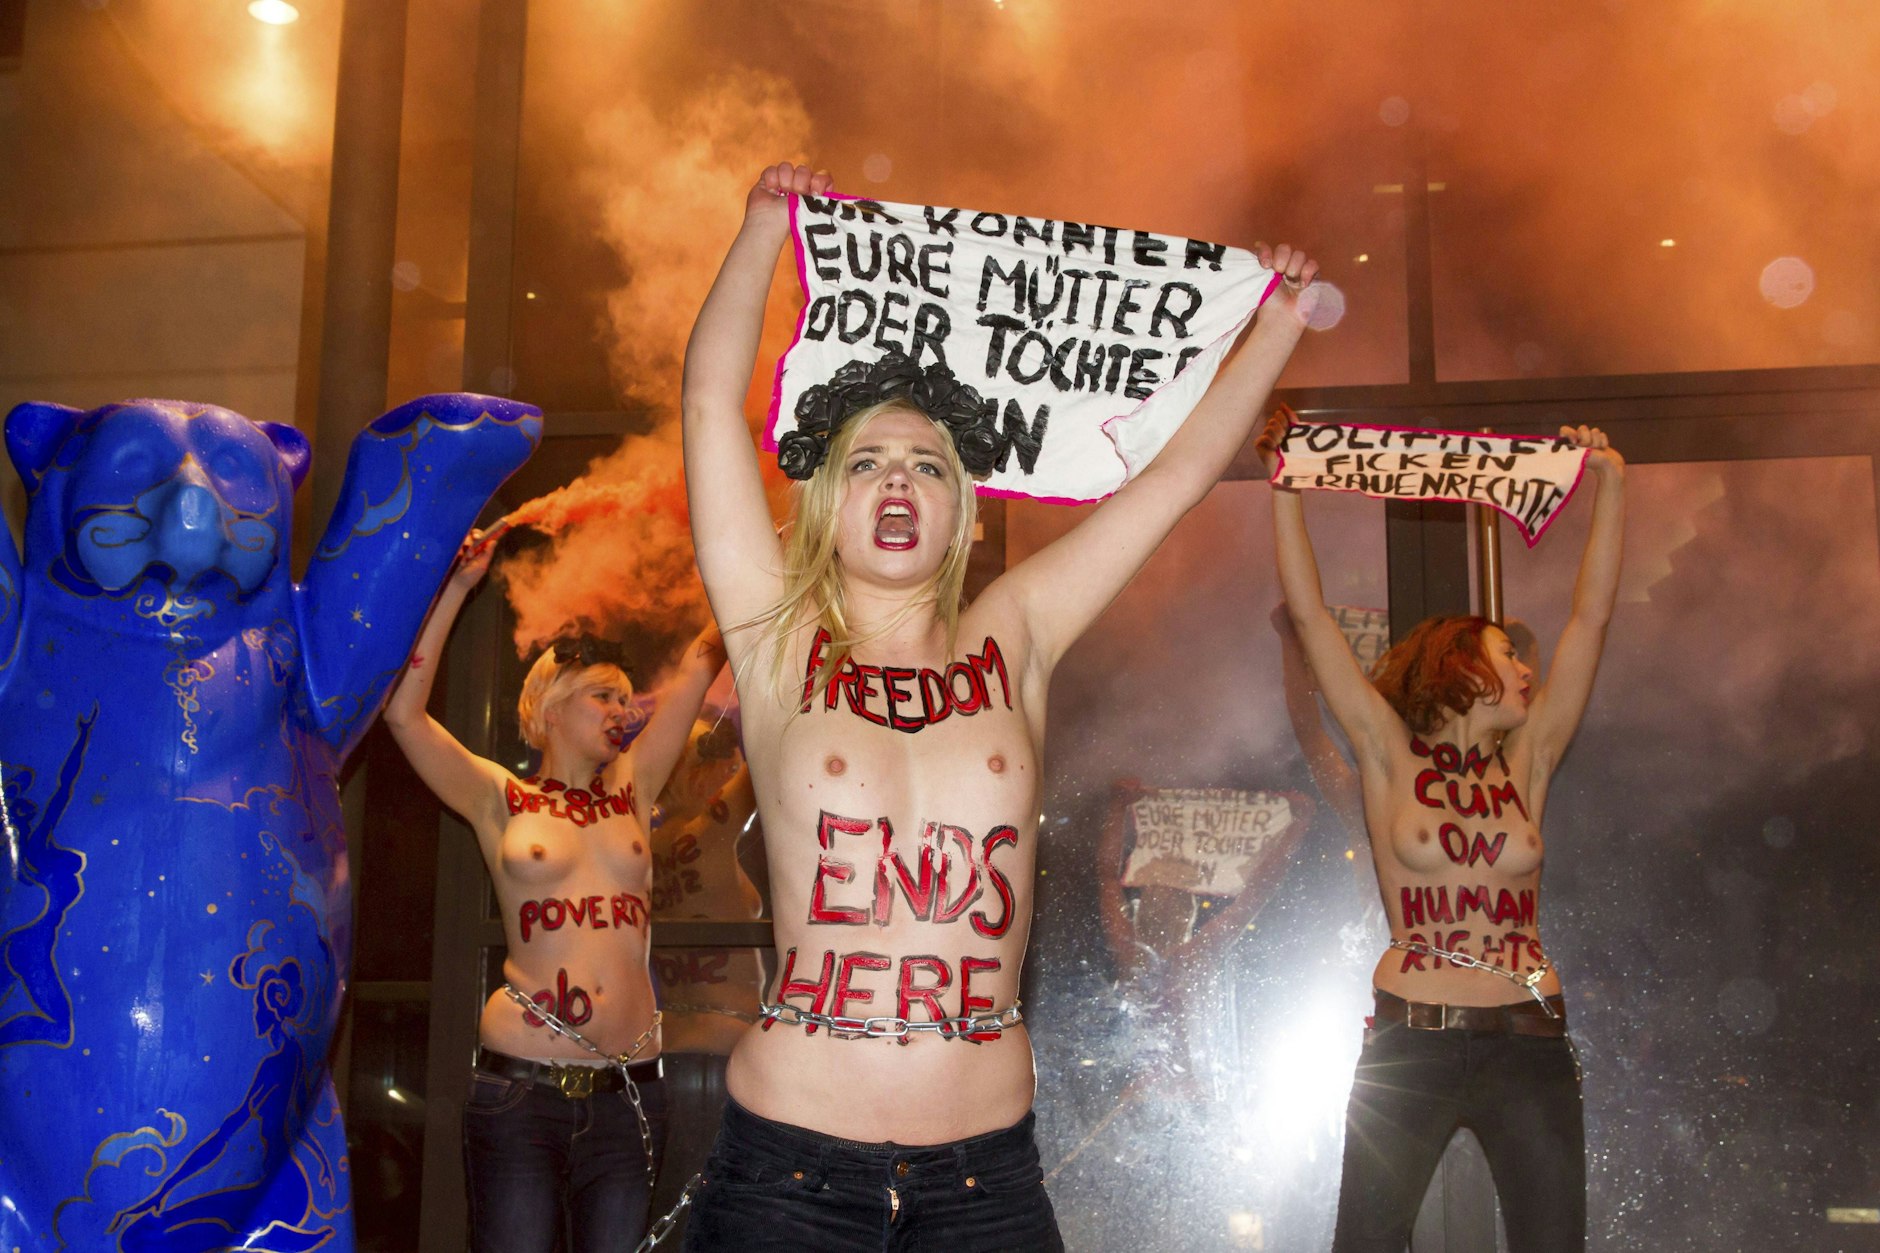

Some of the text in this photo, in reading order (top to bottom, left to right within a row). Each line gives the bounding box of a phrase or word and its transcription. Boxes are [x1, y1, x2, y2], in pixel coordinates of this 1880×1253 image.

[805, 222, 1203, 338] EURE MÜTTER
[805, 289, 952, 364] ODER
[1326, 452, 1517, 474] FICKEN
[800, 627, 1013, 733] FREEDOM
[1415, 768, 1529, 822] CUM
[807, 809, 1018, 940] ENDS
[1438, 822, 1508, 868] ON
[1400, 885, 1535, 928] HUMAN
[1400, 930, 1546, 973] RIGHTS
[761, 947, 1003, 1045] HERE
